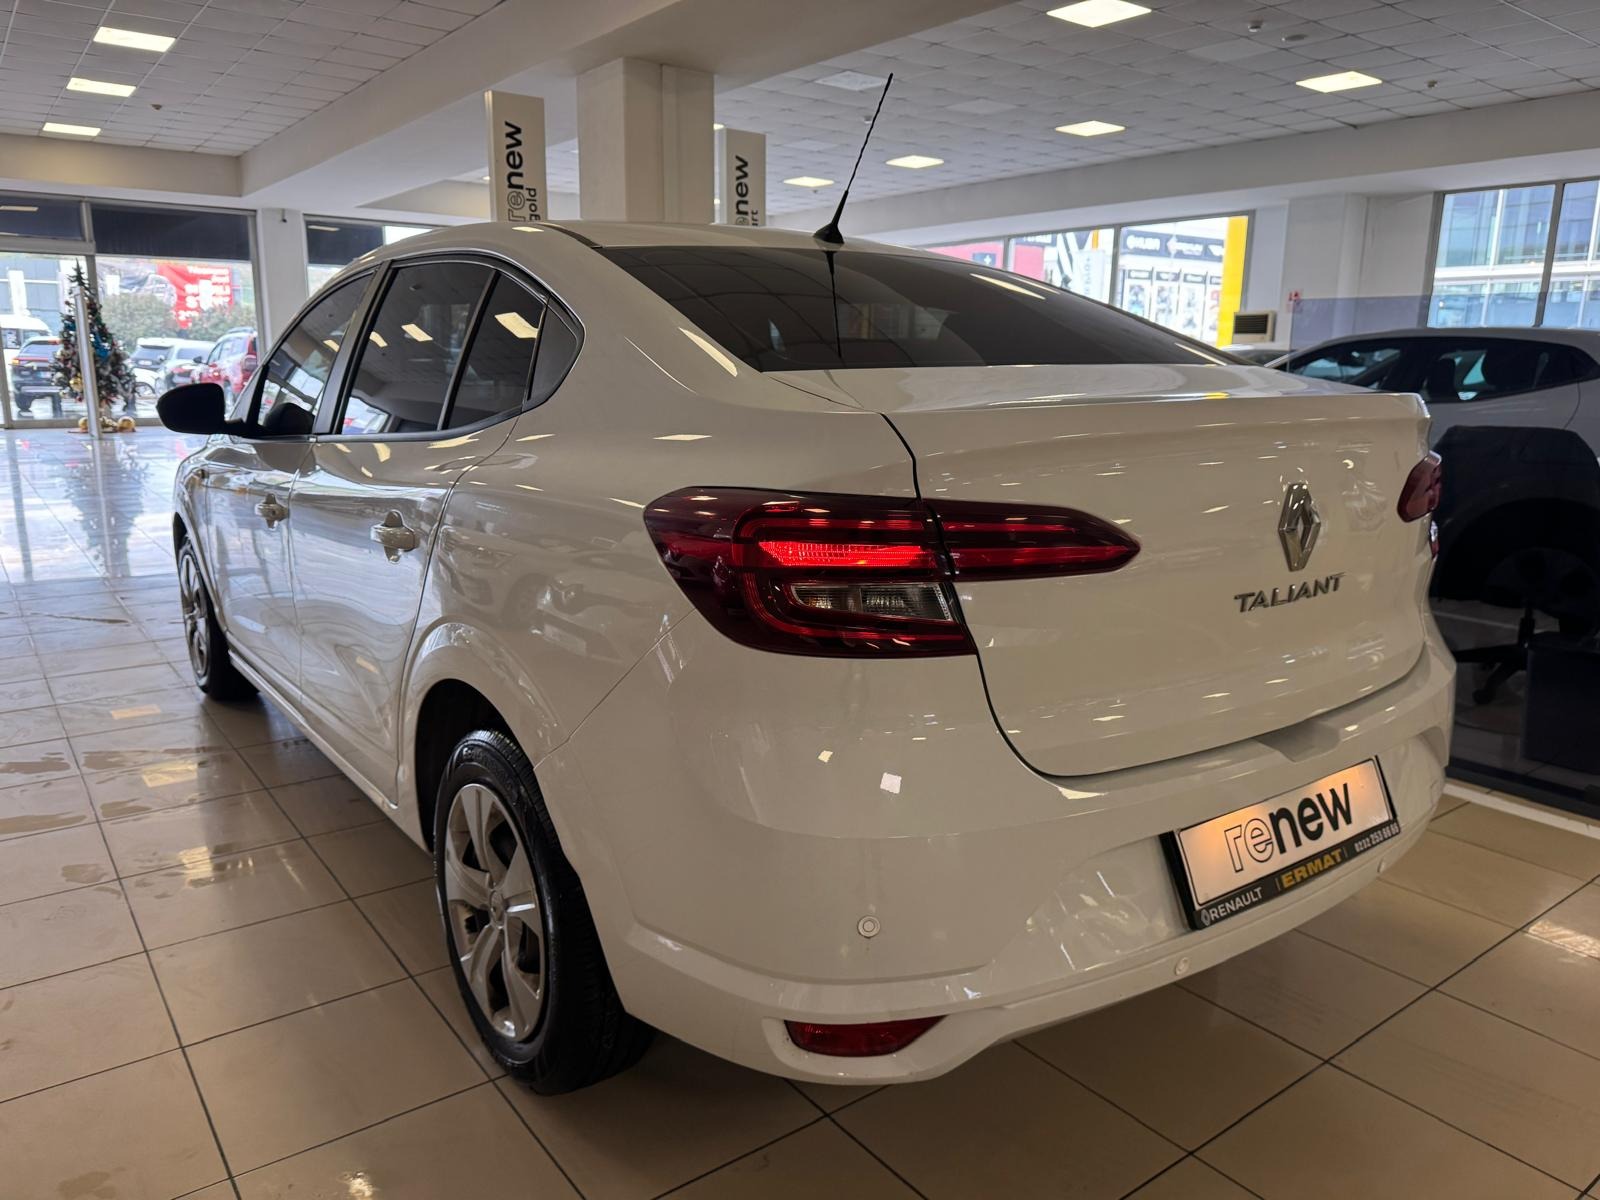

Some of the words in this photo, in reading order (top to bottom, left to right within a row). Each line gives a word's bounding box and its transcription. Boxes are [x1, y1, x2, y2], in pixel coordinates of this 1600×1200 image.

[504, 120, 527, 222] renew
[526, 187, 541, 221] gold
[735, 155, 749, 225] enew
[1234, 572, 1346, 613] TALIANT
[1224, 783, 1352, 873] renew
[1210, 886, 1263, 921] RENAULT
[1281, 849, 1343, 889] ERMAT
